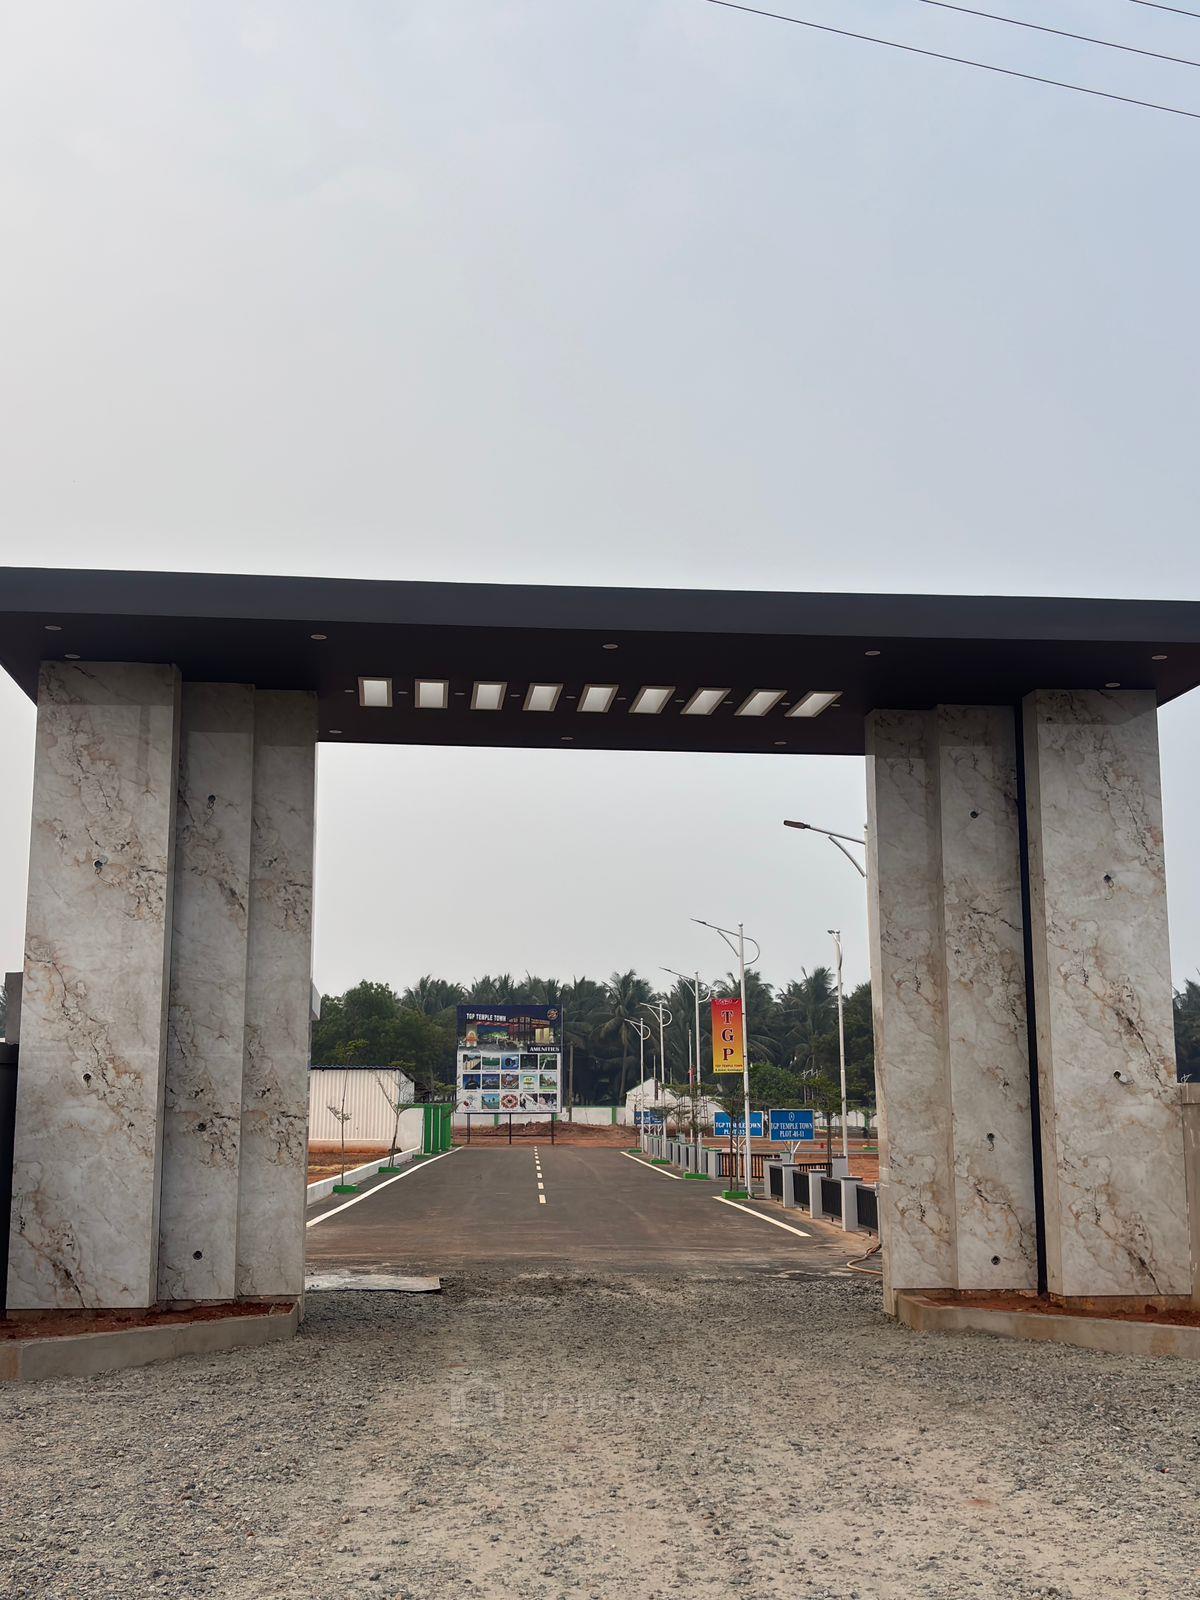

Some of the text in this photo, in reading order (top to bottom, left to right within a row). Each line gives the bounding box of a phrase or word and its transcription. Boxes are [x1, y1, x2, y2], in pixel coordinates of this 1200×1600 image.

[494, 1014, 507, 1022] TOWN
[770, 1122, 813, 1130] TGP TEMPLE TOWN
[779, 1130, 792, 1138] PLOT
